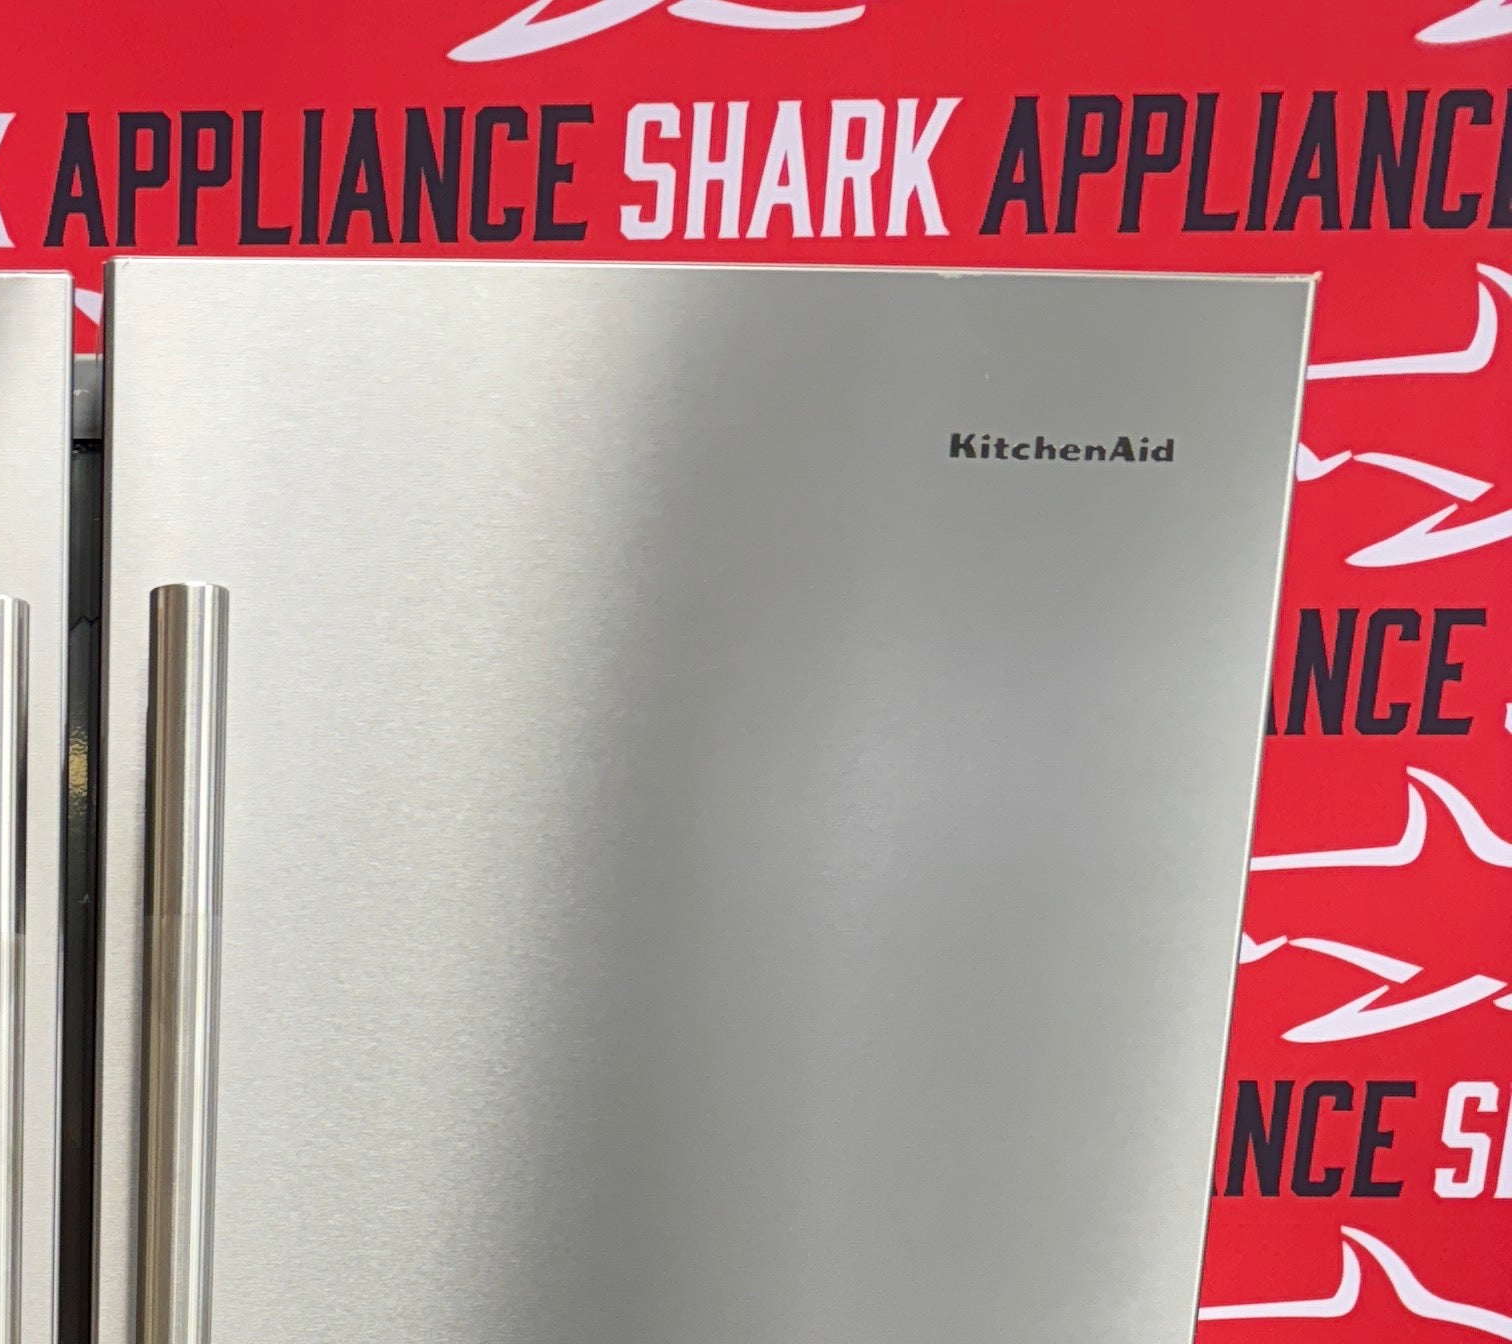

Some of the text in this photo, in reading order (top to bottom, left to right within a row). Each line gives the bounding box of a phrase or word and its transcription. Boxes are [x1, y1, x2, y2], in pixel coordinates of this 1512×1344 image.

[43, 104, 594, 248] APPLIANCE
[619, 97, 962, 241] SHARK
[949, 432, 1175, 462] KitchenAid
[1266, 608, 1487, 736] NCE
[1210, 1080, 1417, 1198] NCE
